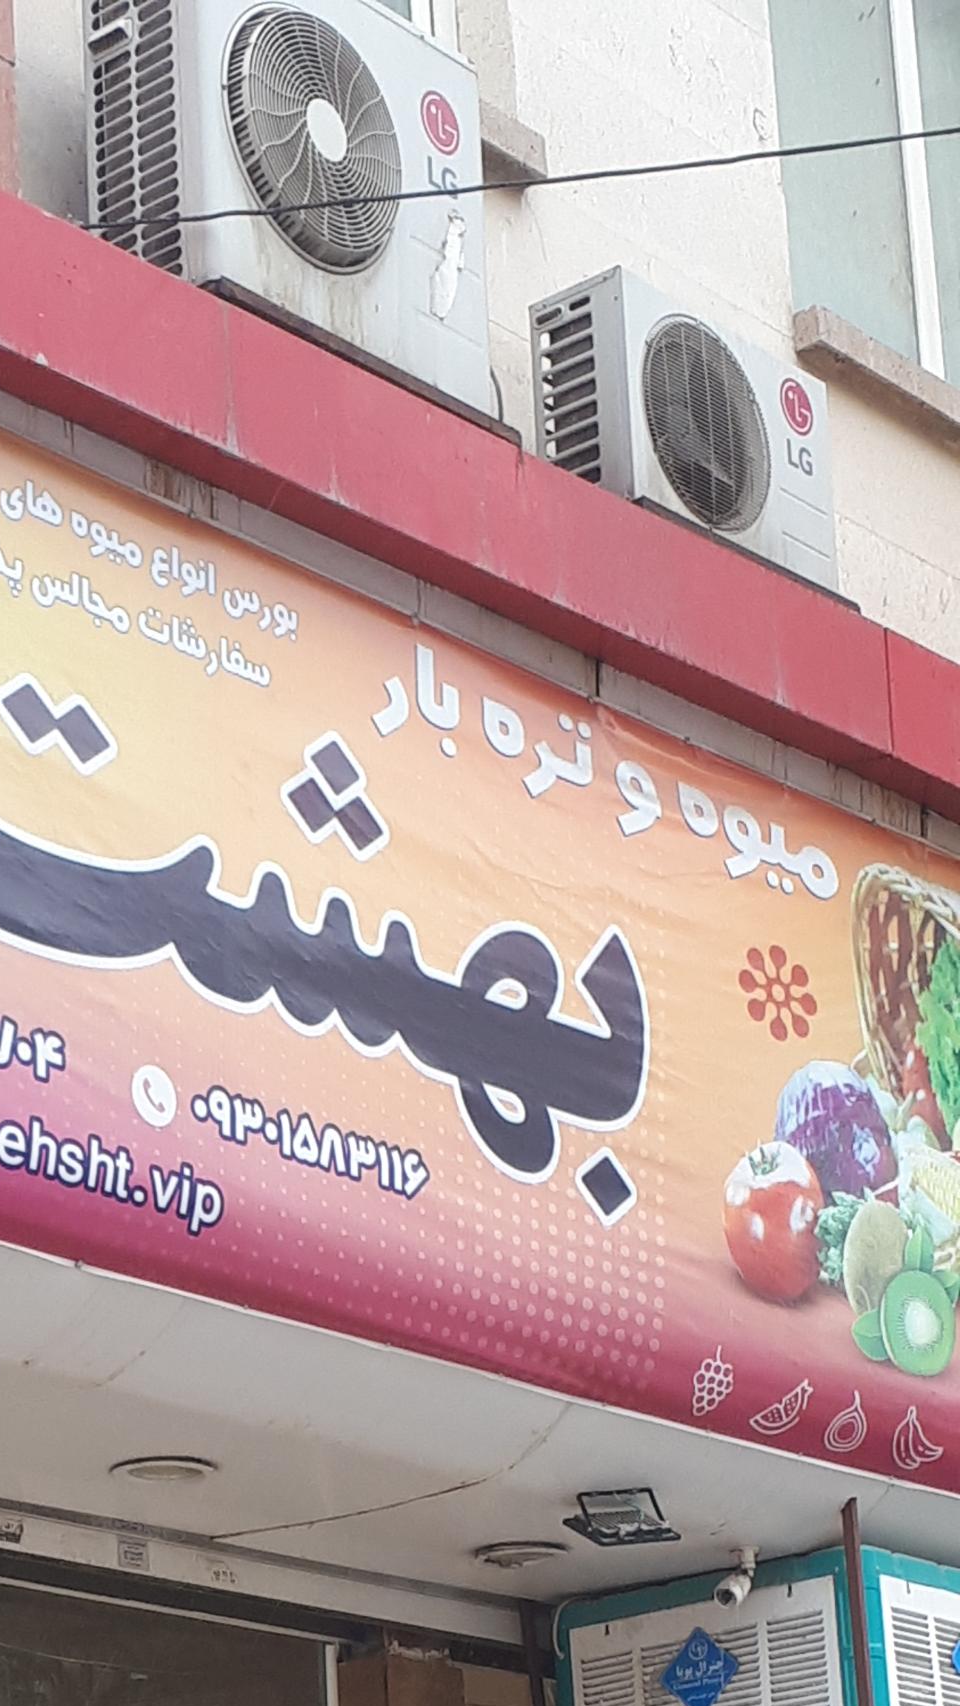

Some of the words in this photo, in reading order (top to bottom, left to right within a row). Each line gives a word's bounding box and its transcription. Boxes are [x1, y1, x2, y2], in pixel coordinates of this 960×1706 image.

[427, 156, 458, 200] LG
[786, 438, 813, 476] LG
[0, 484, 63, 527] های
[70, 510, 142, 568] میوه
[151, 546, 216, 595] انواع
[31, 573, 131, 634] مجالس
[224, 582, 299, 640] بورس
[139, 606, 272, 688] سفارشات
[370, 642, 460, 757] بار
[482, 693, 594, 799] تره
[615, 759, 662, 836] و
[677, 780, 839, 899] میوه
[190, 1085, 430, 1201] ۰۹۳۰۱۵۸۳۱۱۶
